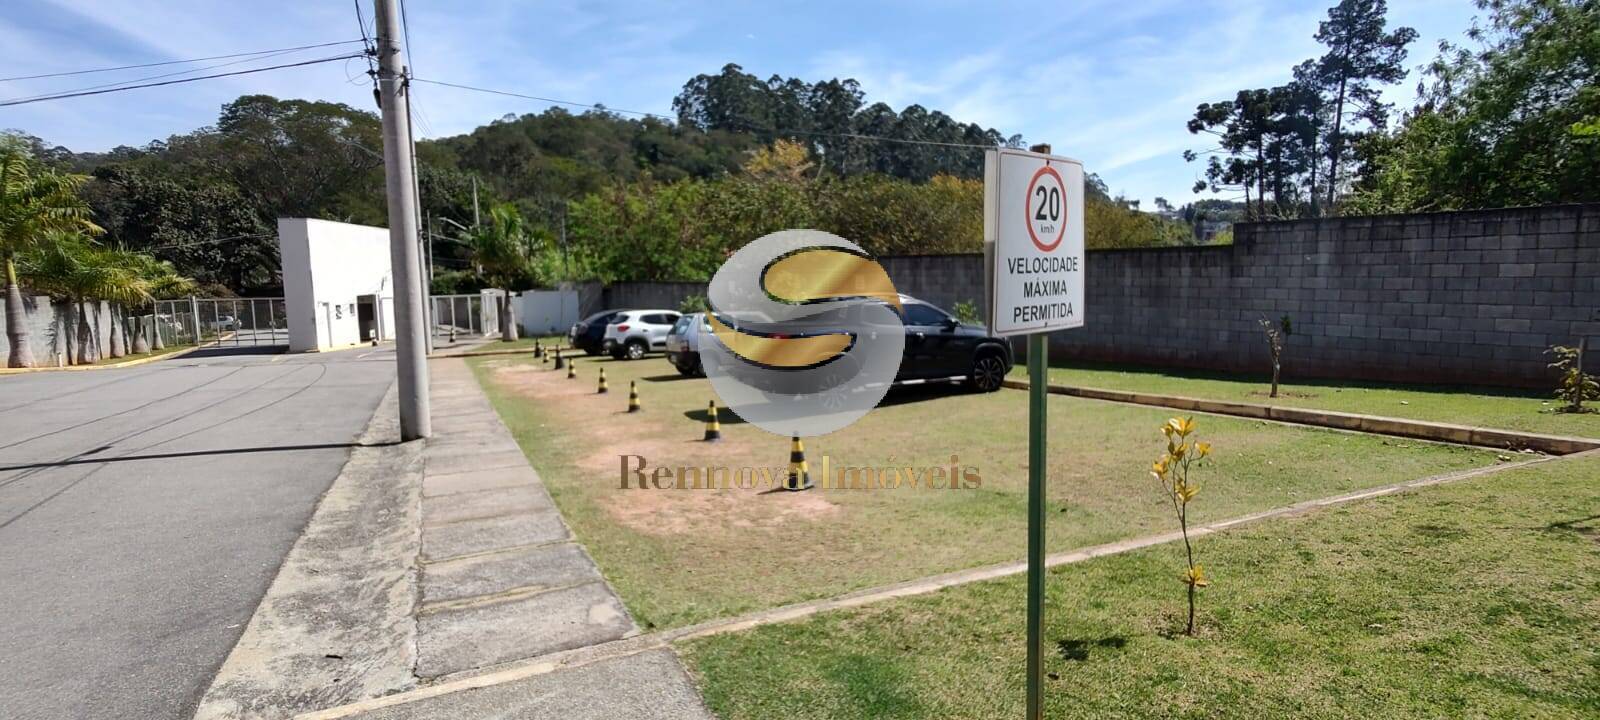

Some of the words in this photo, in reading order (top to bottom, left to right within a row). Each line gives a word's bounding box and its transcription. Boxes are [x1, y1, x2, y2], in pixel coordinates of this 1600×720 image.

[1035, 185, 1060, 222] 20
[1007, 256, 1078, 275] VELOCIDADE
[1023, 278, 1067, 298] MÁXIMA
[1013, 302, 1073, 323] PERMITIDA
